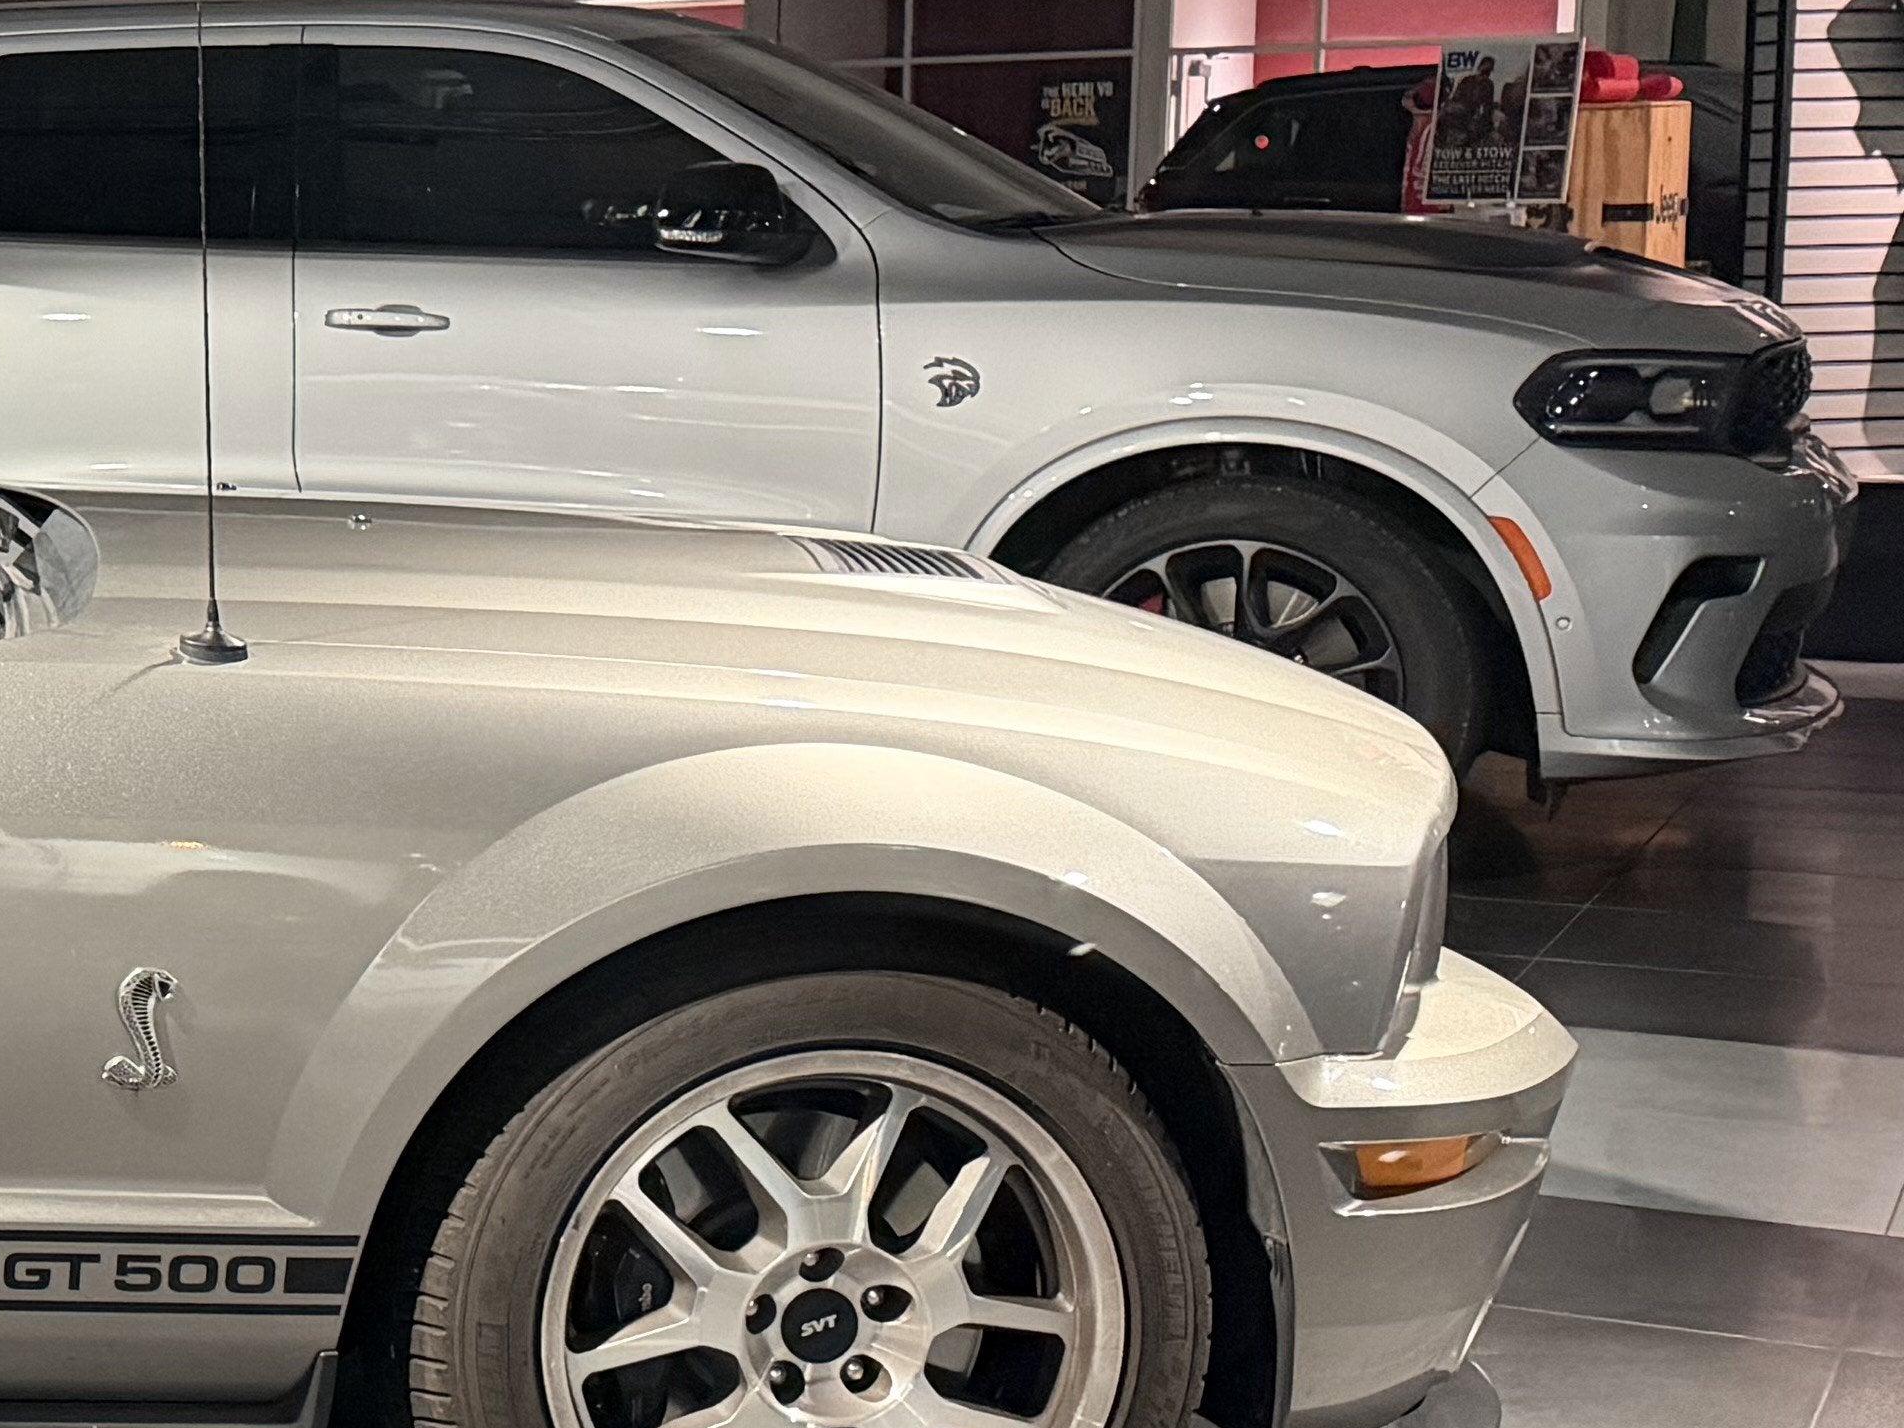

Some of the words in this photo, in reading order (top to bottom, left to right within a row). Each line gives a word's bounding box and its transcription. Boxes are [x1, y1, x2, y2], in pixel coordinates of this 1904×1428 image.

[1050, 97, 1097, 118] BACK
[1435, 147, 1463, 160] TOW
[1476, 147, 1512, 160] STOW
[1656, 184, 1679, 234] Jeep
[2, 1253, 101, 1290] GT
[113, 1254, 276, 1294] 500
[800, 1313, 838, 1338] SVT
